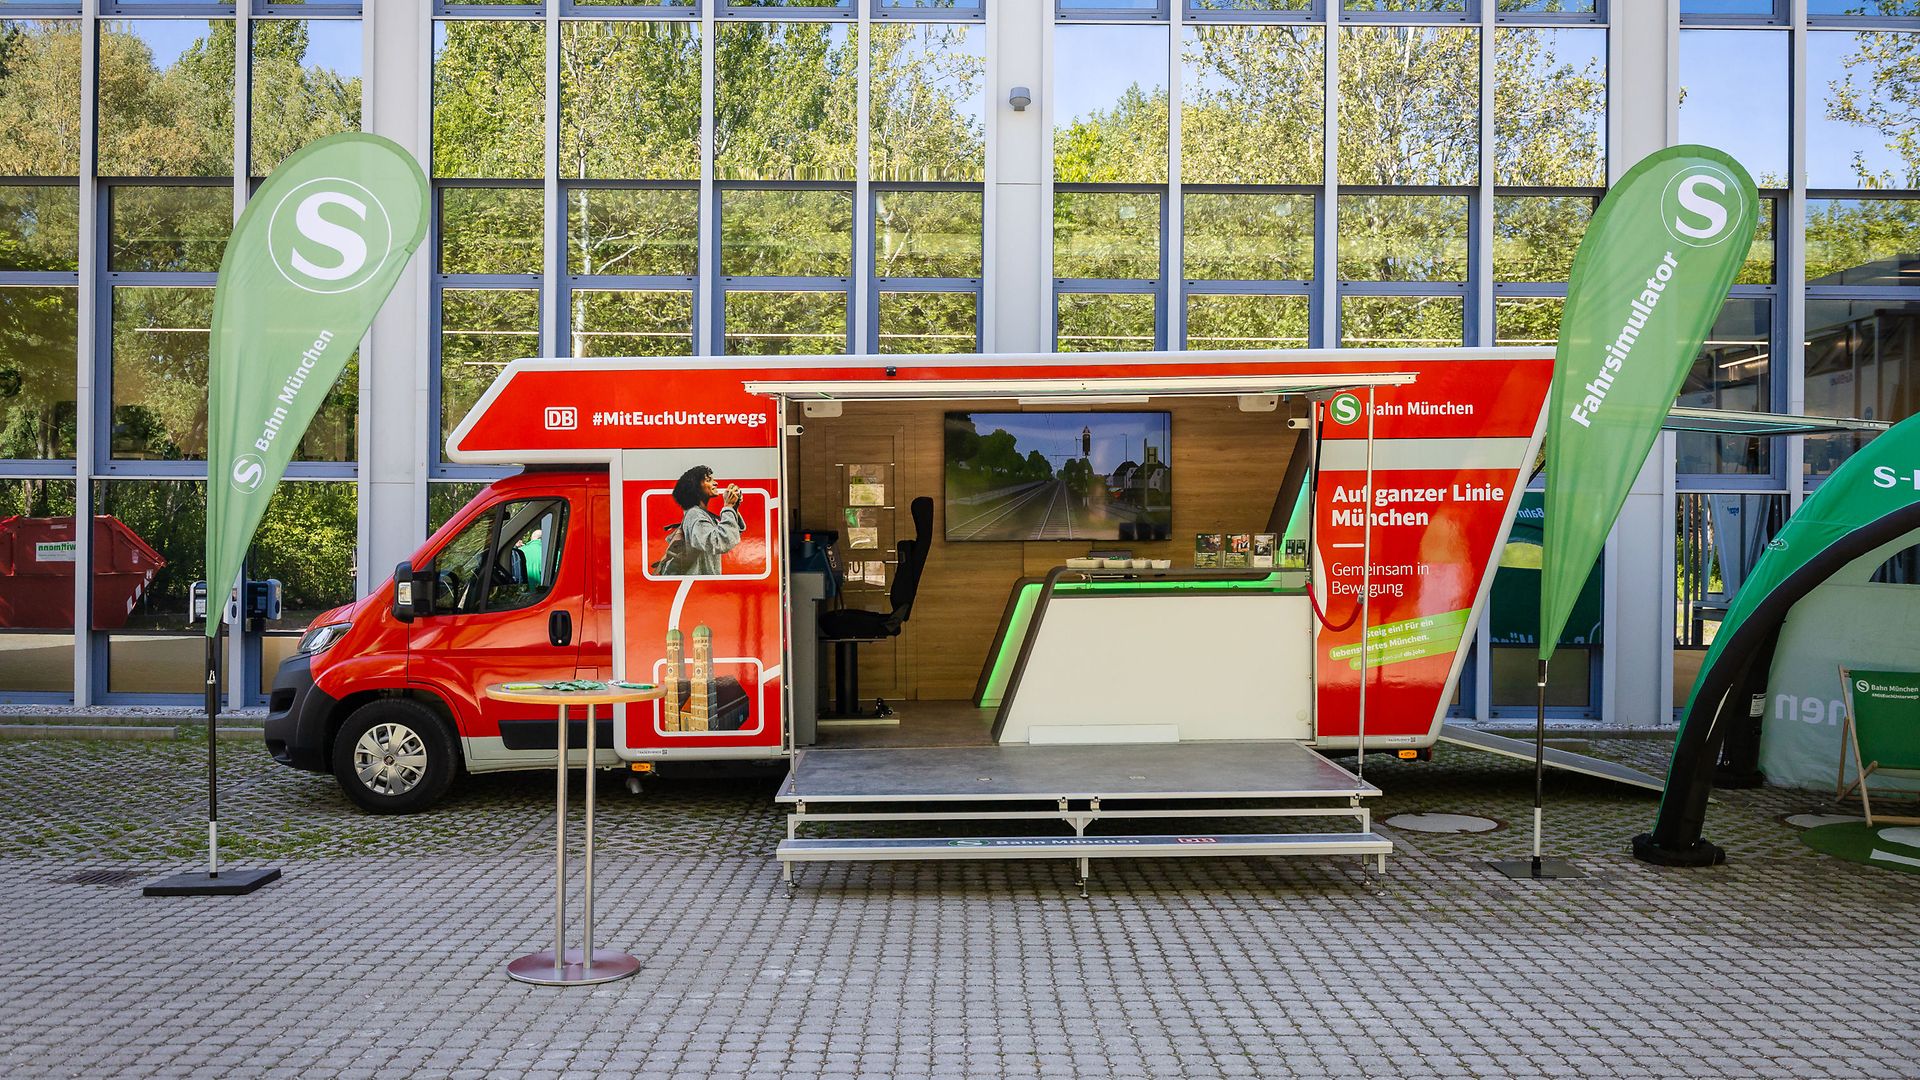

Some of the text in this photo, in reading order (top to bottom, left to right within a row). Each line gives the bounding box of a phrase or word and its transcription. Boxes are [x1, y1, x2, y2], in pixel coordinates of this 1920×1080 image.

[1675, 174, 1728, 239] S
[291, 191, 367, 281] S
[1570, 250, 1679, 429] Fahrsimulator
[254, 405, 288, 452] Bahn
[277, 328, 335, 405] München
[548, 409, 575, 427] DB
[592, 411, 767, 427] #MitEuchUnterwegs
[1336, 397, 1357, 422] S
[1407, 401, 1474, 415] München
[1375, 487, 1447, 507] ganzer
[1453, 483, 1504, 501] Linie
[1417, 562, 1429, 575] in
[1405, 621, 1419, 631] Für
[1421, 619, 1434, 628] ein
